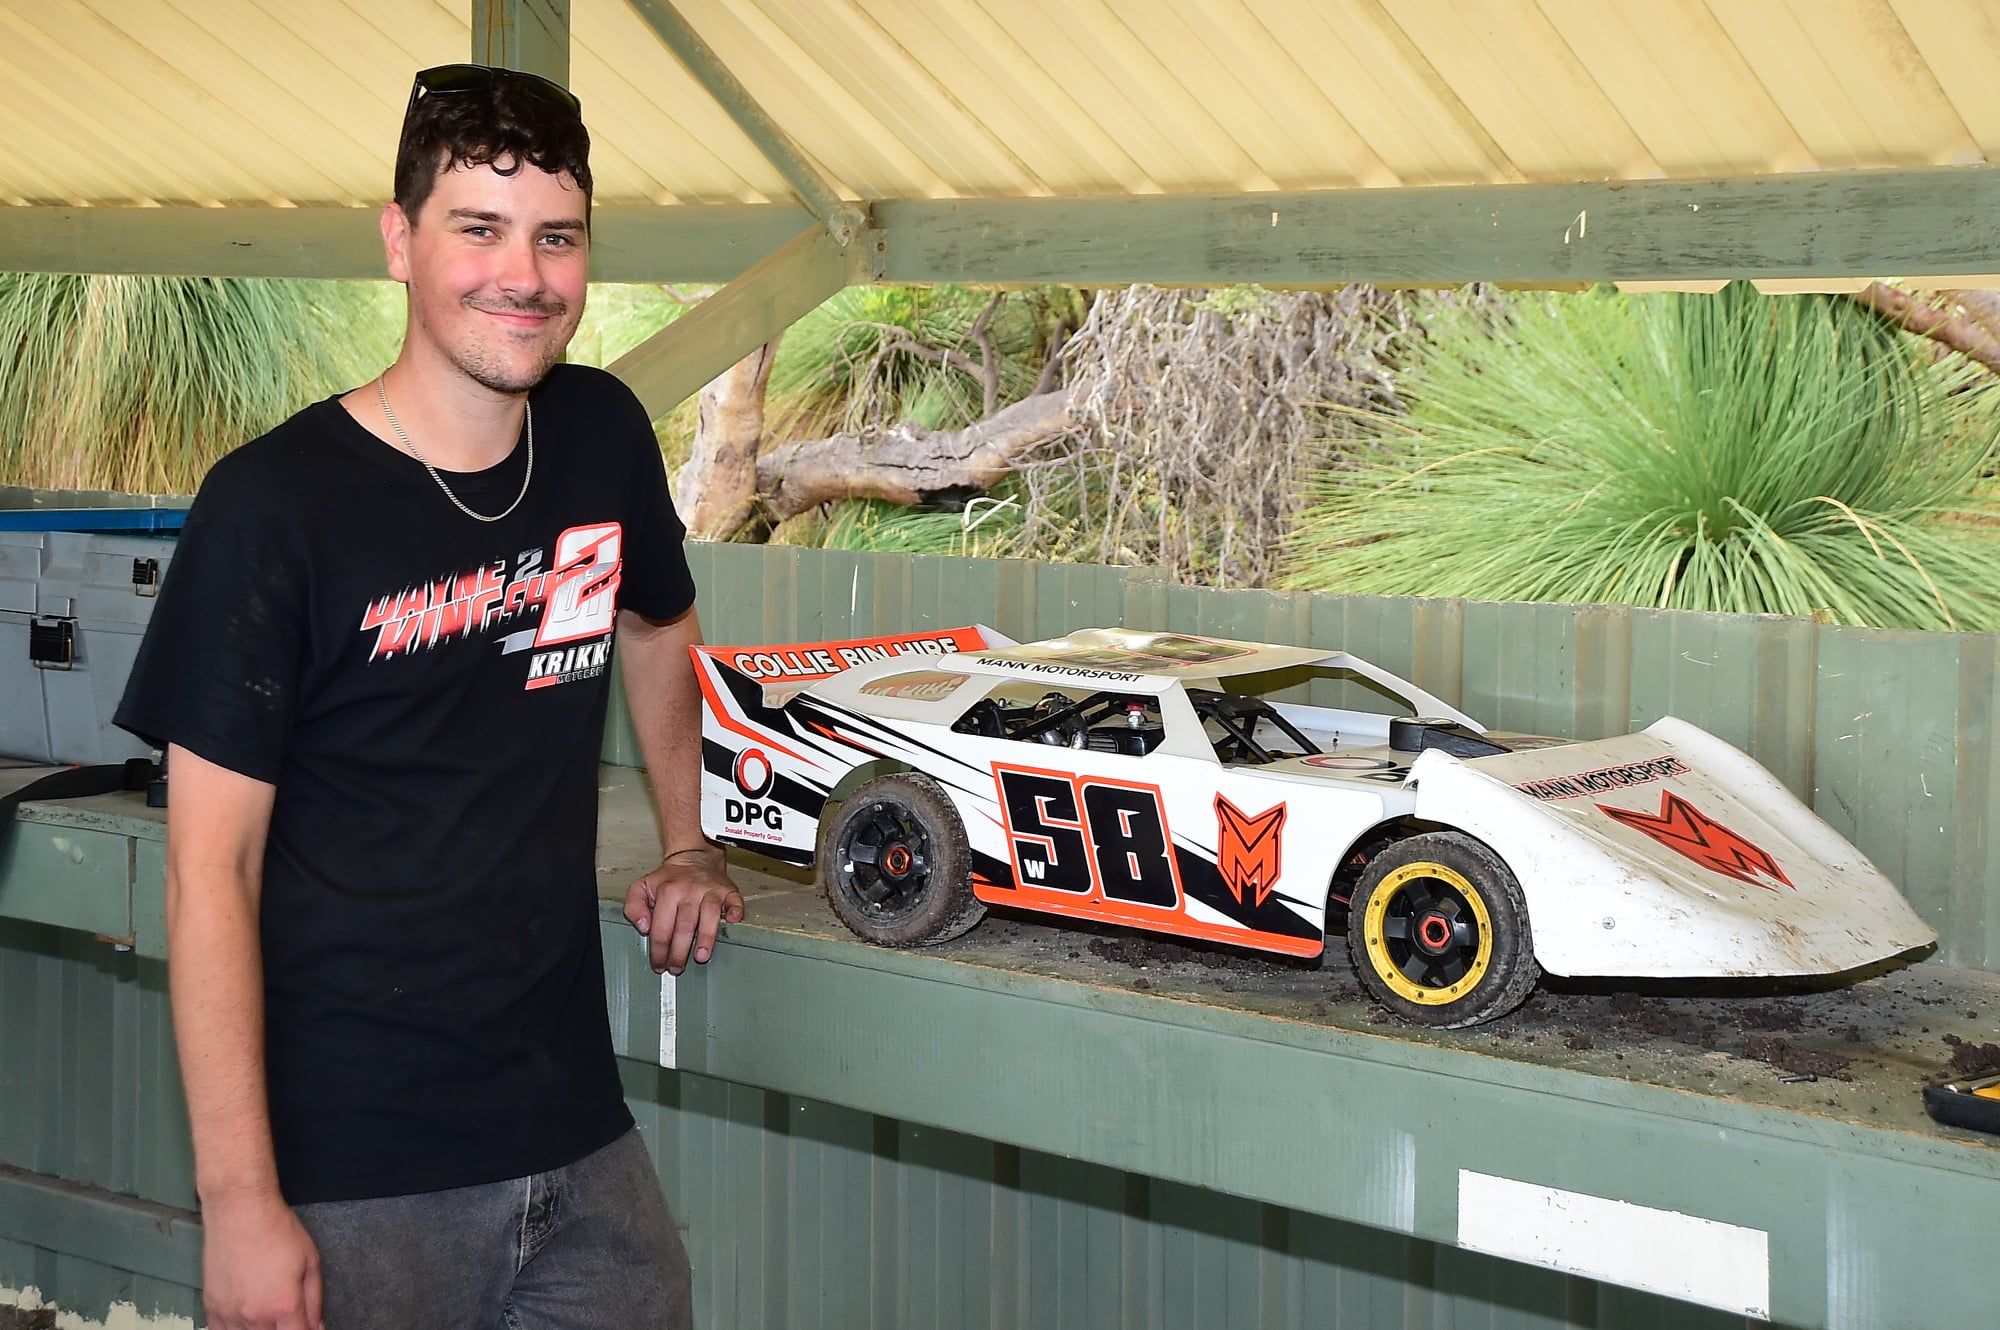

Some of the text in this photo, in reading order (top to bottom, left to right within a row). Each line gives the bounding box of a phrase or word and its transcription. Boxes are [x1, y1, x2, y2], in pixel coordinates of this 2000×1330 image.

[534, 521, 622, 648] 2
[527, 641, 611, 680] KRIKK
[733, 648, 841, 679] COLLIE
[838, 644, 892, 669] BIN
[976, 657, 1144, 684] MANN MOTORSPORT
[1516, 755, 1690, 800] MANN MOTORSPORT
[725, 798, 783, 831] DPG
[724, 826, 783, 842] Donald Property Group
[994, 764, 1182, 911] 58
[1024, 858, 1046, 880] W
